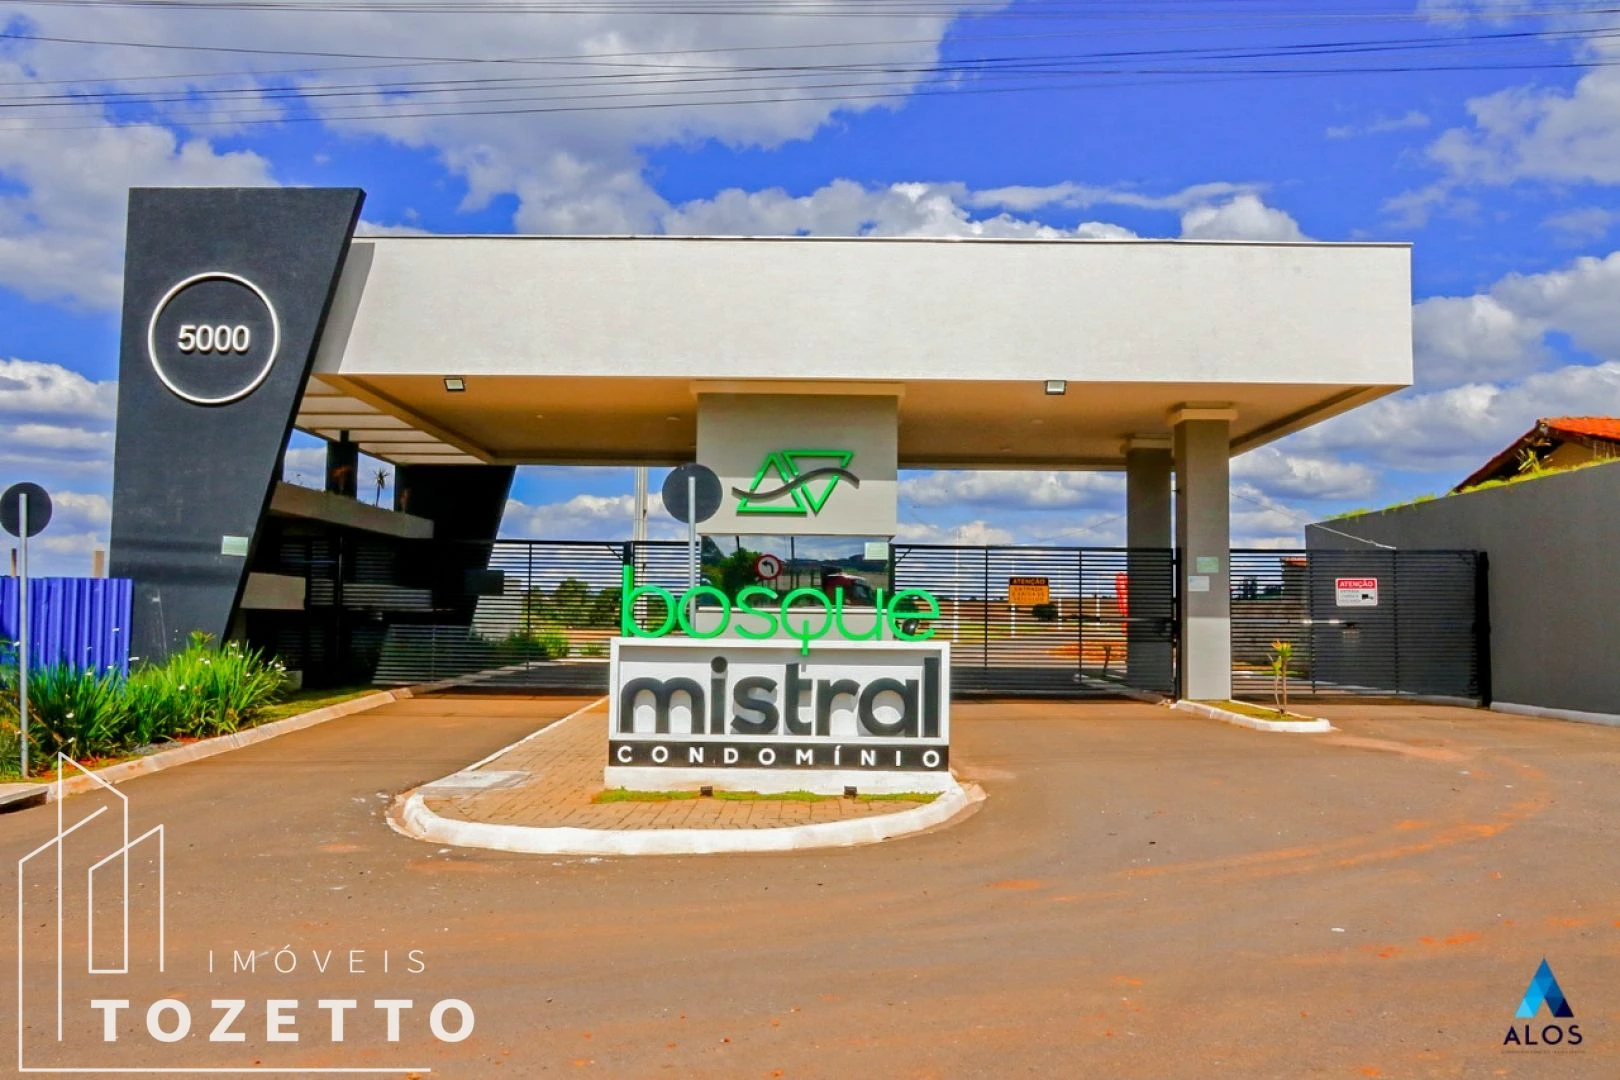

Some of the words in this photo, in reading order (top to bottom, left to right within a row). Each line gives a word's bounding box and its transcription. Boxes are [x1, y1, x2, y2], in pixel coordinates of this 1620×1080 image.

[178, 325, 250, 353] 5000
[1339, 580, 1374, 589] ATENÇÃO
[622, 565, 940, 656] bosque
[620, 656, 938, 738] mistral
[617, 745, 941, 767] CONDOMÍNIO
